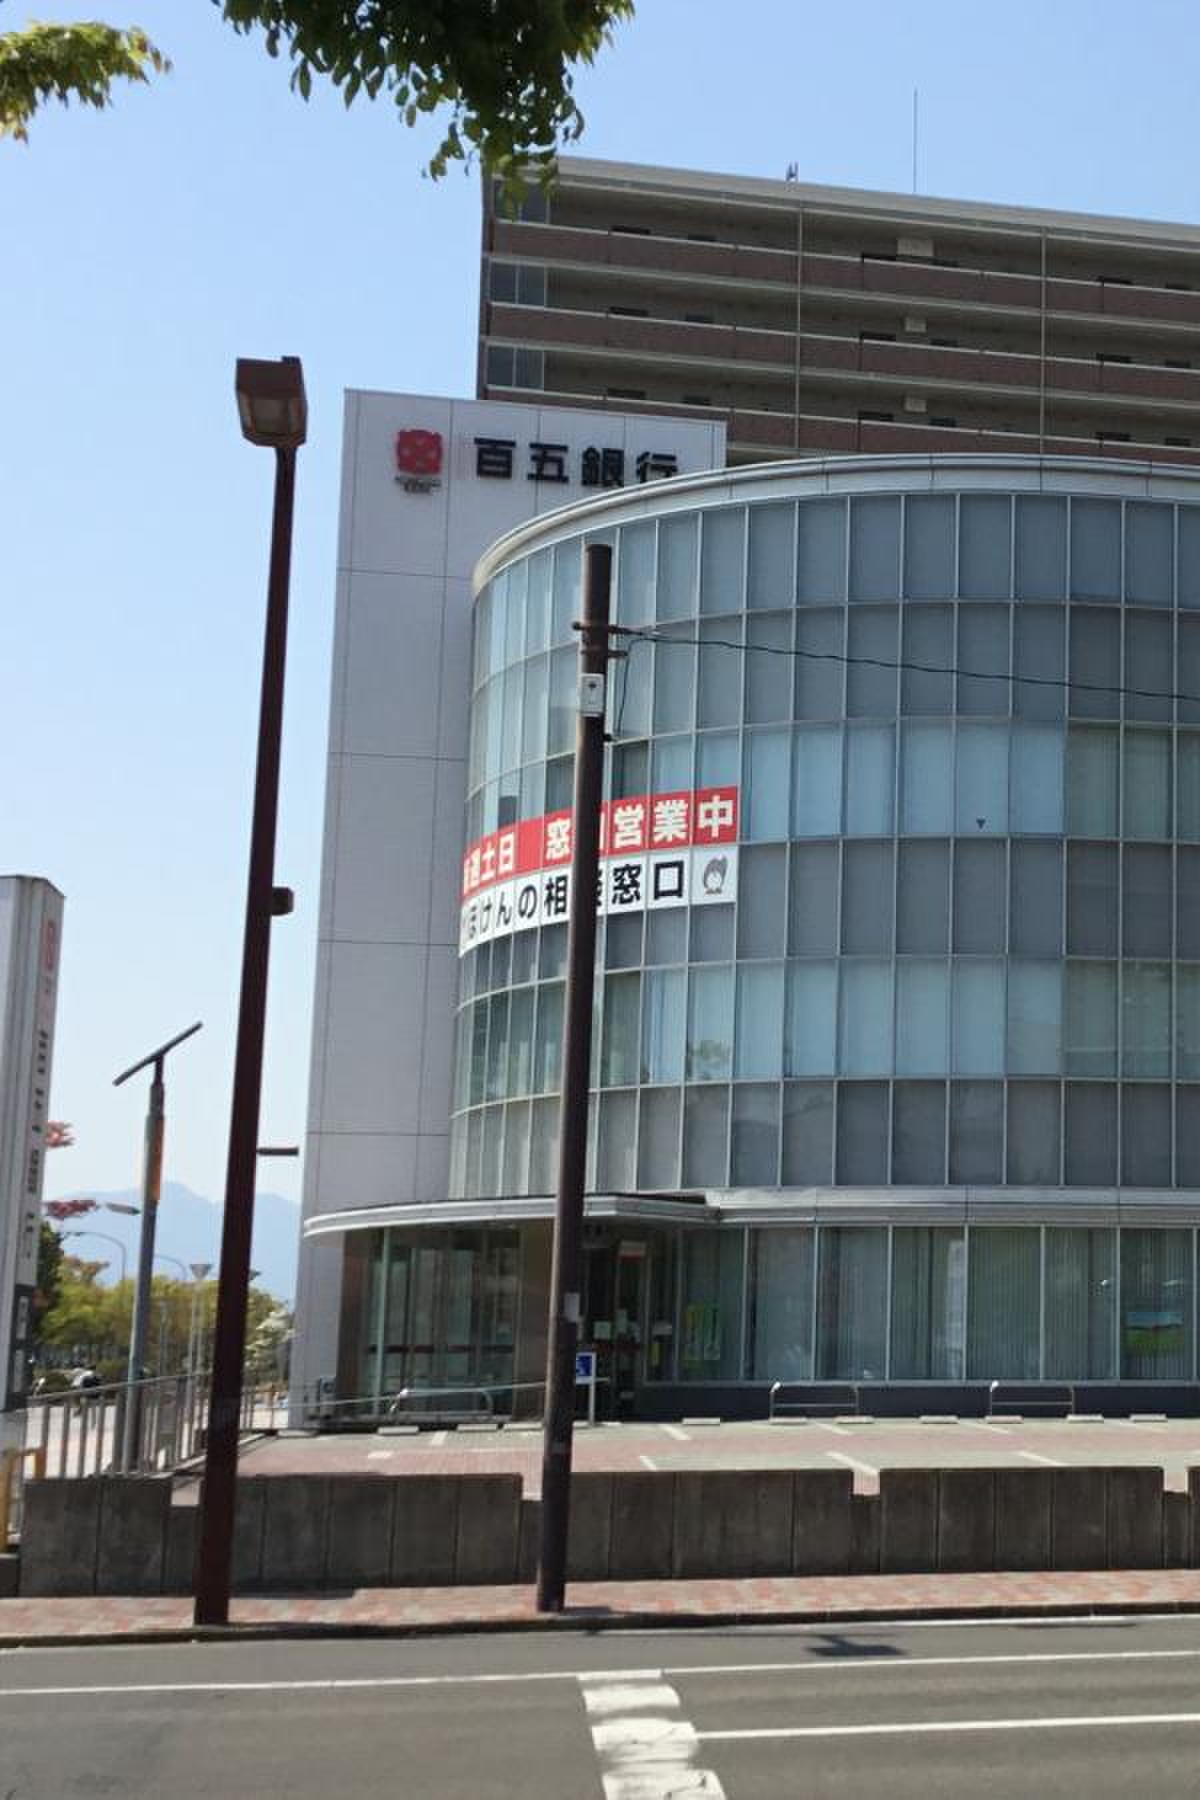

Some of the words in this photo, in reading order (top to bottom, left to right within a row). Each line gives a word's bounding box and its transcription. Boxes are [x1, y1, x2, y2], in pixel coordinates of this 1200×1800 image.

[545, 794, 734, 860] 窓営業中
[463, 859, 685, 941] ほけんの相窓口
